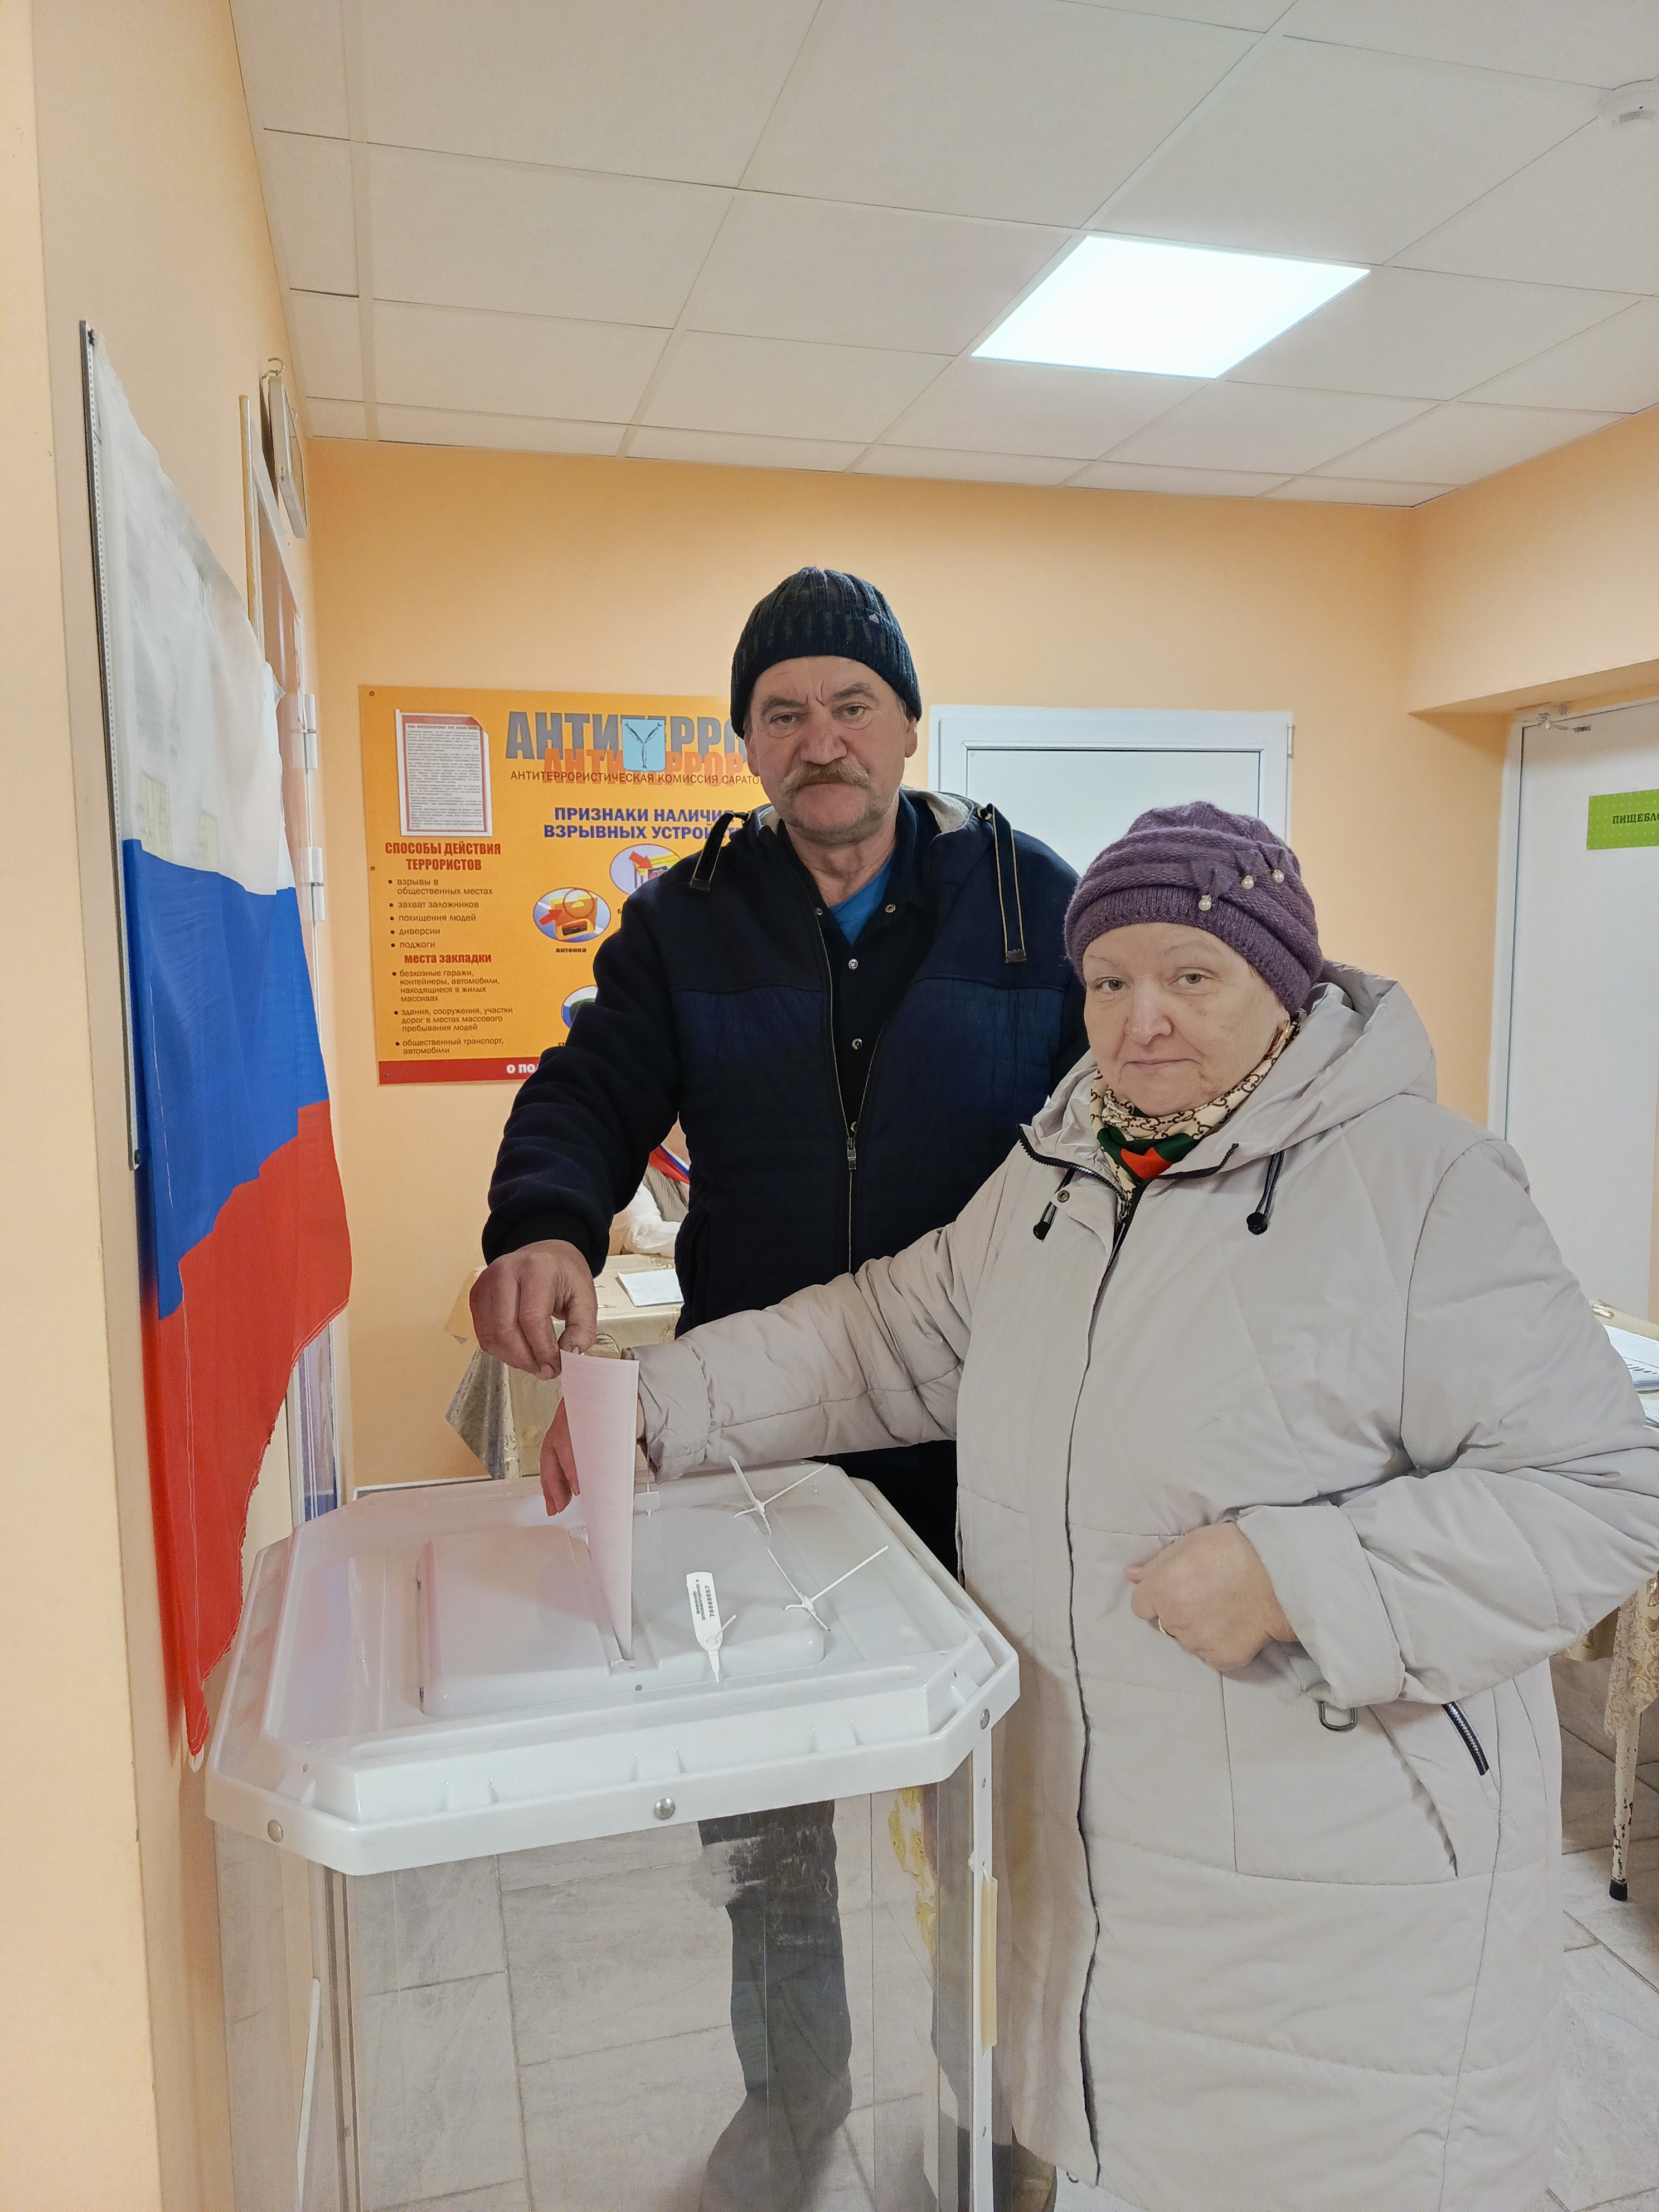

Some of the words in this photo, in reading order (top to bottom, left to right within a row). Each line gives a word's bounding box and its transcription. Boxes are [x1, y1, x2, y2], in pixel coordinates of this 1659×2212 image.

[510, 771, 653, 783] АНТИТЕРРОРИСТИЧЕСКАЯ
[658, 773, 719, 784] КОМИССИЯ
[722, 775, 760, 784] САРАТО
[555, 807, 649, 822] ПРИЗНАКИ
[544, 825, 648, 839] ВЗРЫВНЫХ
[385, 842, 442, 854] СПОСОБЫ
[444, 841, 501, 856] ДЕЙСТВИЯ
[406, 858, 482, 870] ТЕРРОРИСТОВ
[397, 887, 461, 895] общественных
[449, 914, 476, 922] людей
[404, 954, 437, 963] места
[439, 954, 492, 964] закладки
[433, 1008, 482, 1016] сооружения,
[402, 1038, 461, 1047] общественный
